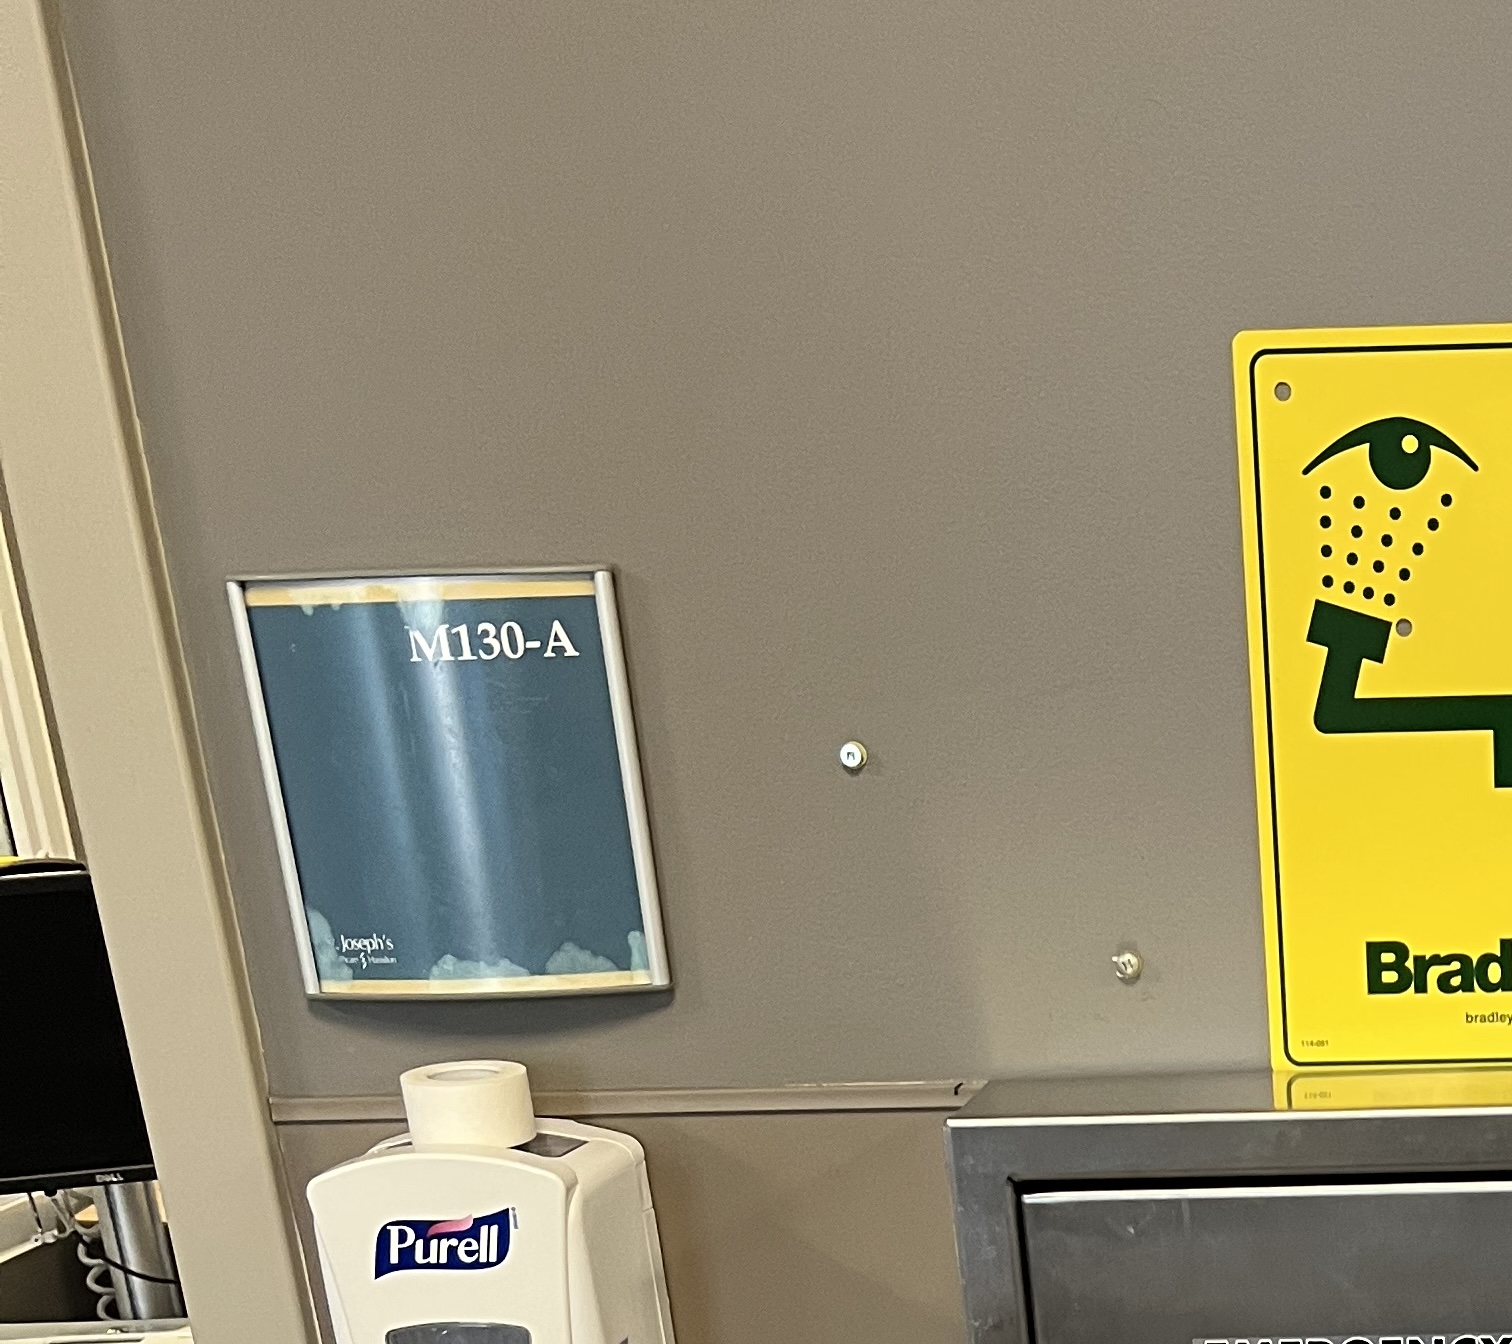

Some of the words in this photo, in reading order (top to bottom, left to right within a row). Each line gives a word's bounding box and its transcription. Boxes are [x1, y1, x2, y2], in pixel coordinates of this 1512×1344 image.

[405, 619, 580, 663] M130-A
[340, 933, 394, 954] Joseph's
[386, 1224, 499, 1264] Purell
